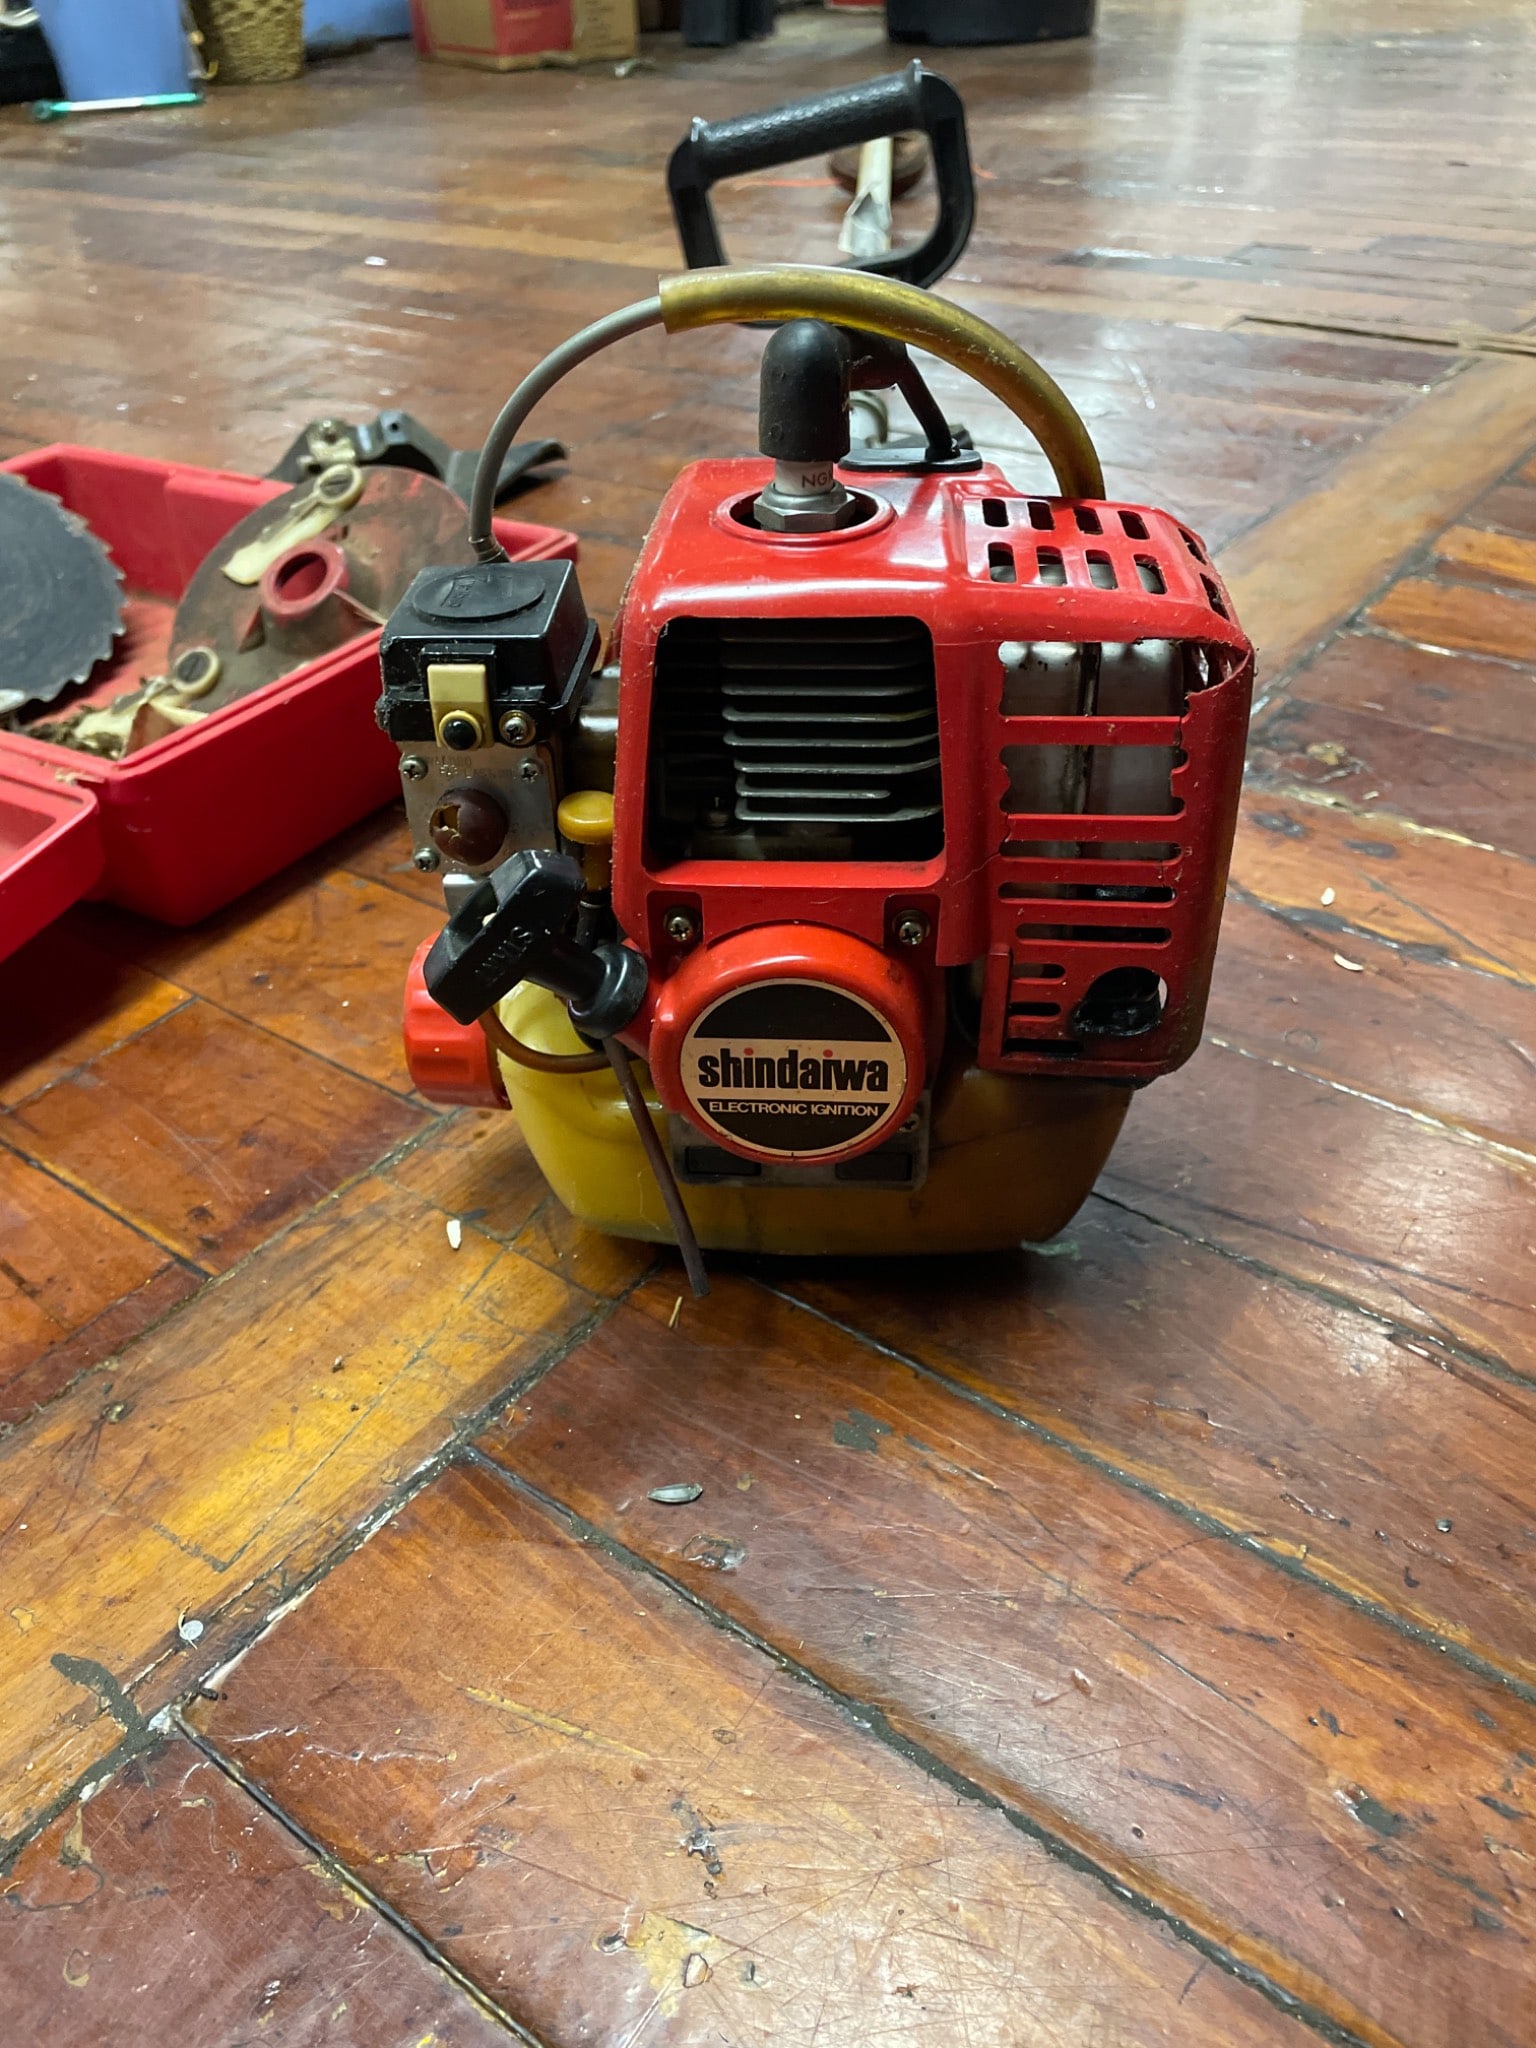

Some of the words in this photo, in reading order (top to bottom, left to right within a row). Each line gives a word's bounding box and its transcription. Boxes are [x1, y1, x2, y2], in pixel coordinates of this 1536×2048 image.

[698, 1047, 889, 1092] shindaiwa
[709, 1101, 808, 1115] ELECTRONIC
[811, 1104, 879, 1117] IGNITION
